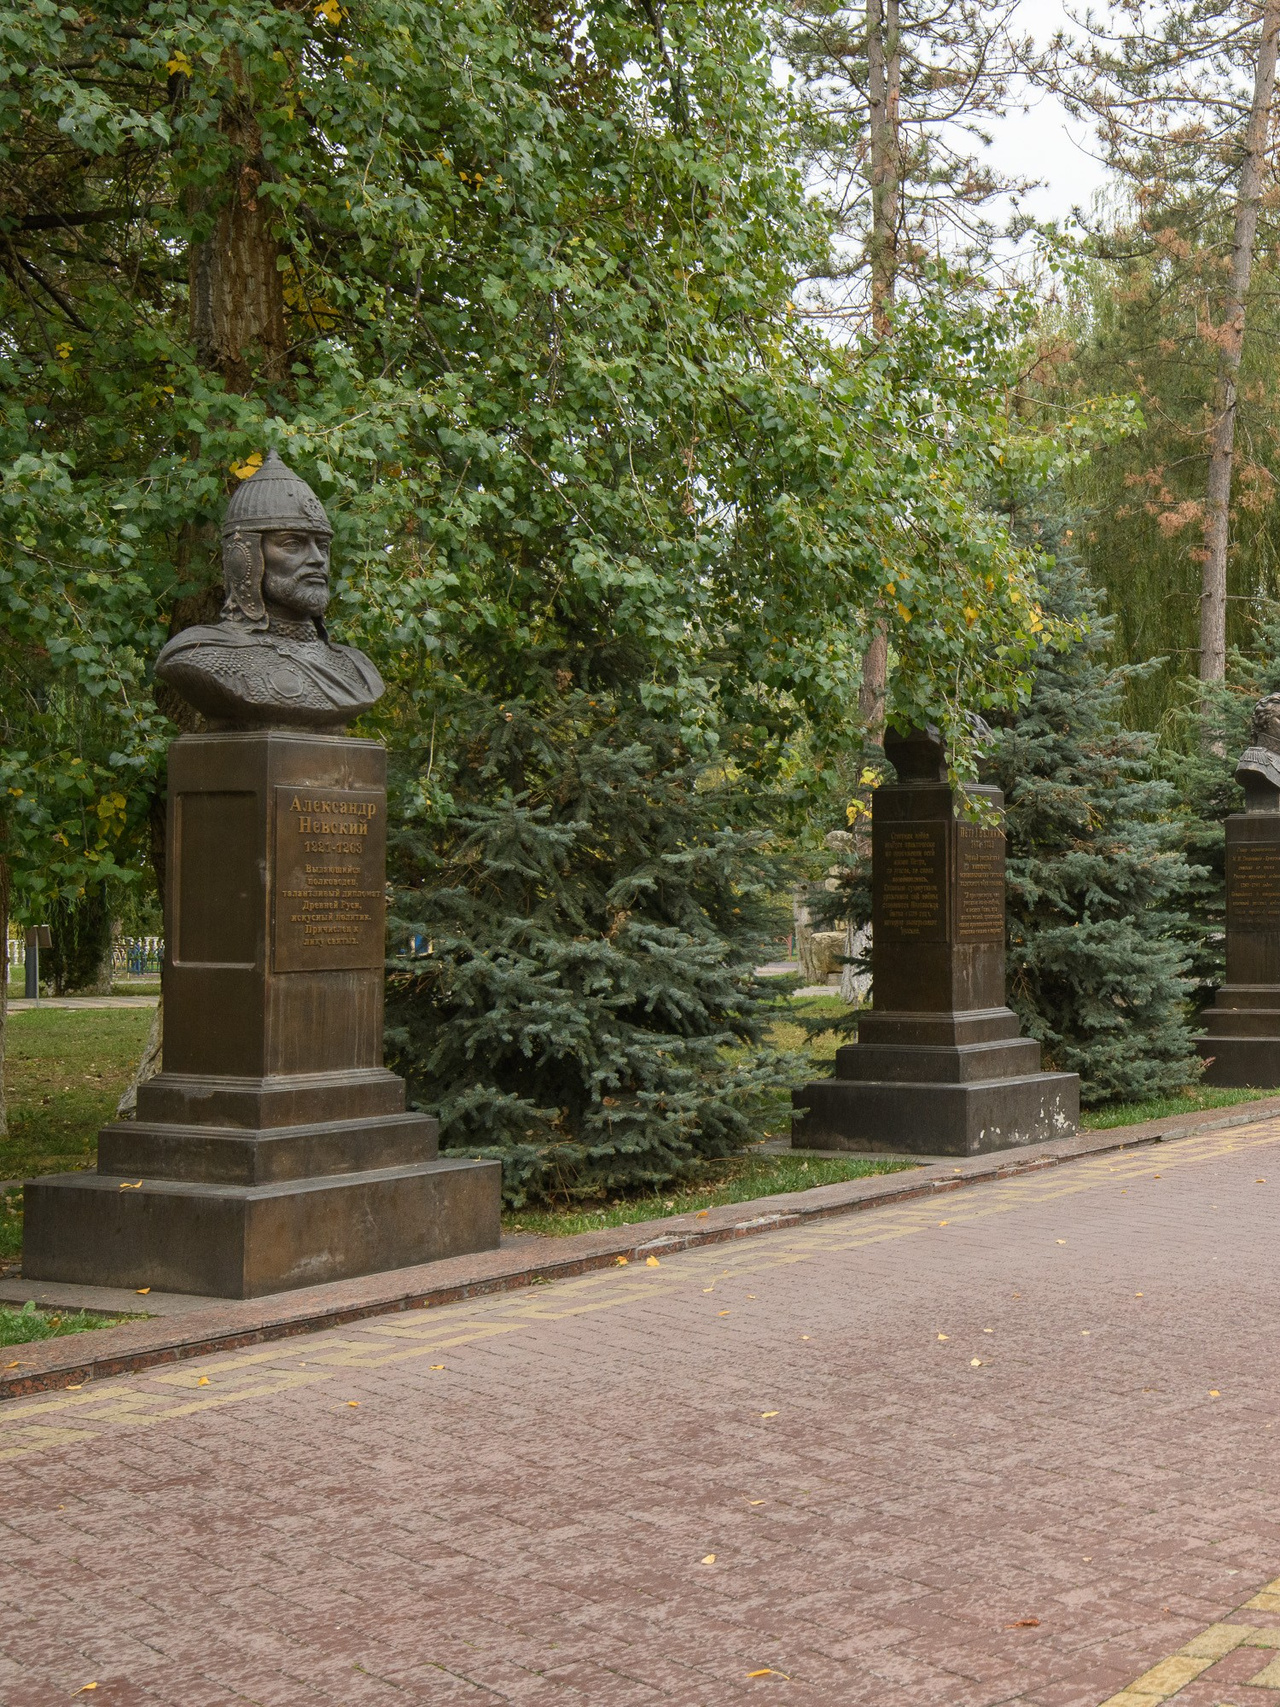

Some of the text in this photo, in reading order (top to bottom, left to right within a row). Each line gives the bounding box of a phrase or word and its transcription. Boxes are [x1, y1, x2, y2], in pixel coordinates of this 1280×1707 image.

[290, 795, 376, 819] Александр
[299, 816, 368, 835] Невский
[304, 841, 362, 854] 1221-1263
[302, 900, 338, 911] Древней
